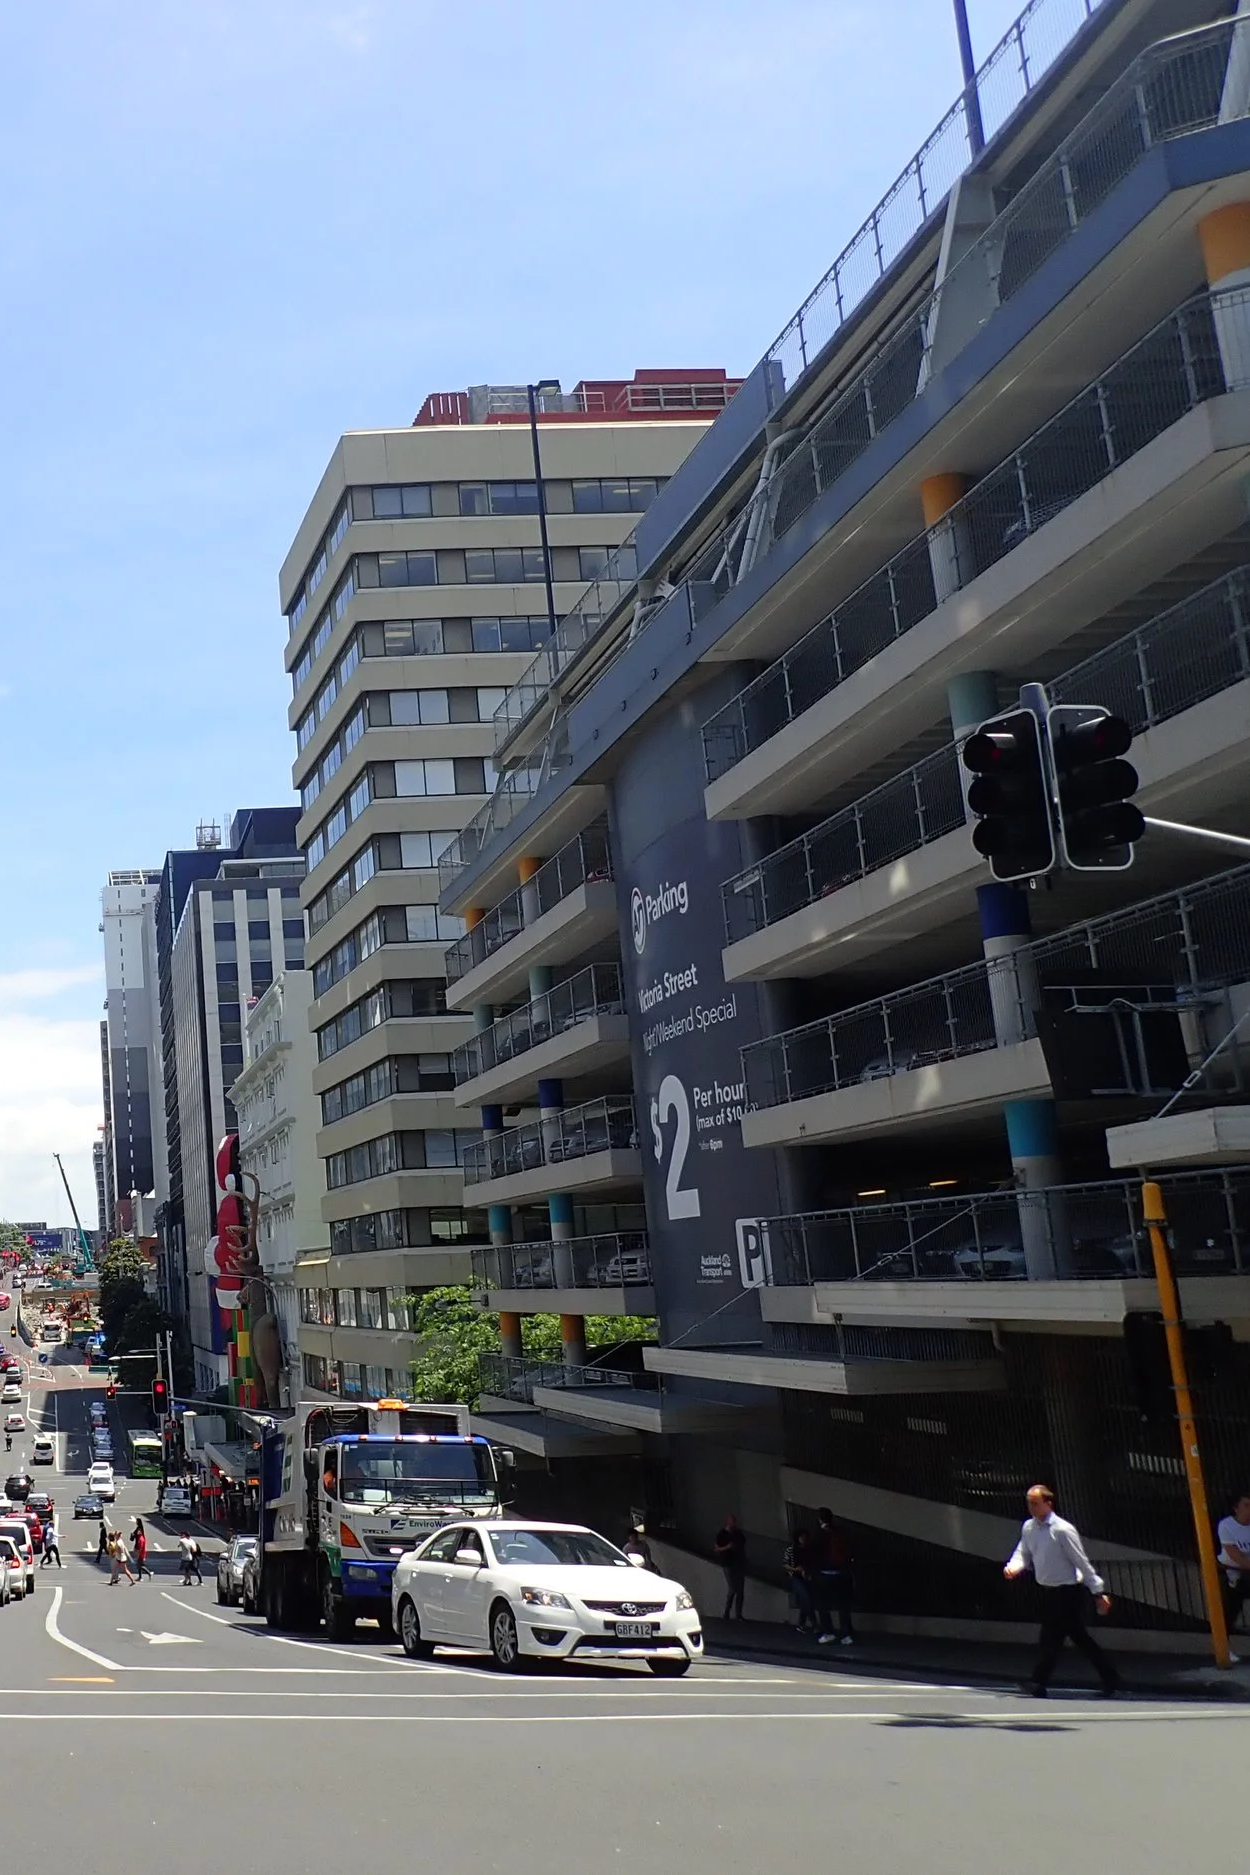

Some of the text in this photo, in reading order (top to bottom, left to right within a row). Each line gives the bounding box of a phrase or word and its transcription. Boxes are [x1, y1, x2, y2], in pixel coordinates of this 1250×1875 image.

[646, 881, 689, 925] Parking
[638, 963, 698, 1014] Victoria Street
[695, 993, 737, 1032] Special
[693, 1081, 744, 1109] Per hour
[696, 1115, 715, 1132] (max
[716, 1108, 725, 1125] of
[742, 1225, 761, 1281] P
[409, 1519, 453, 1529] EnviroWa
